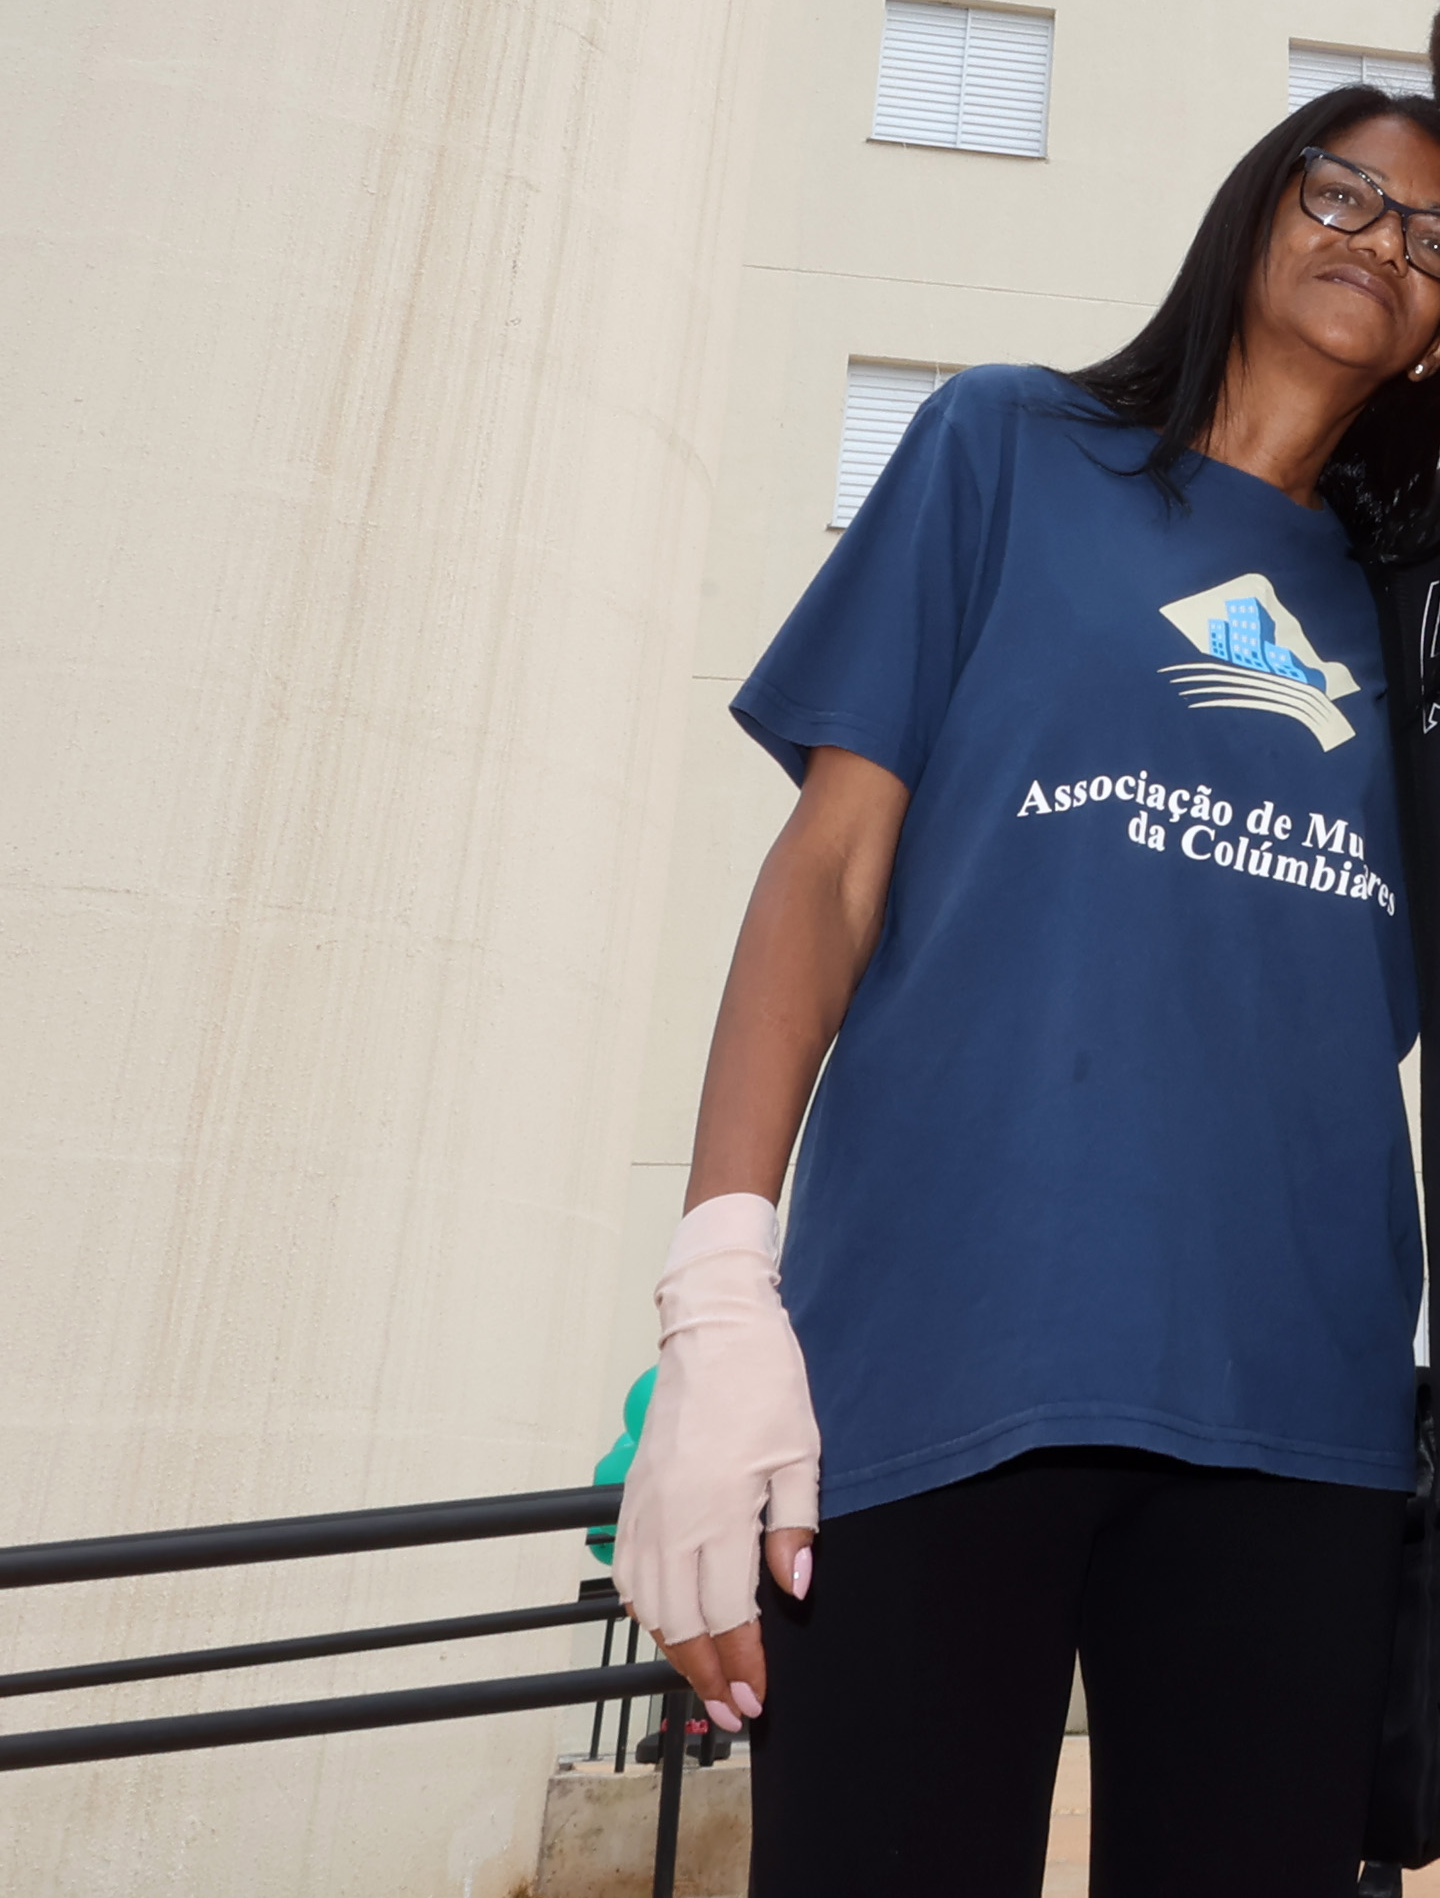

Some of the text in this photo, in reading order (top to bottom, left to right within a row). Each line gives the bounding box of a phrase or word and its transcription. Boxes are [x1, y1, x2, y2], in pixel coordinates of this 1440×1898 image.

[1016, 769, 1233, 827] Associação
[1246, 801, 1292, 840] de
[1127, 810, 1369, 900] da Colúmbia
